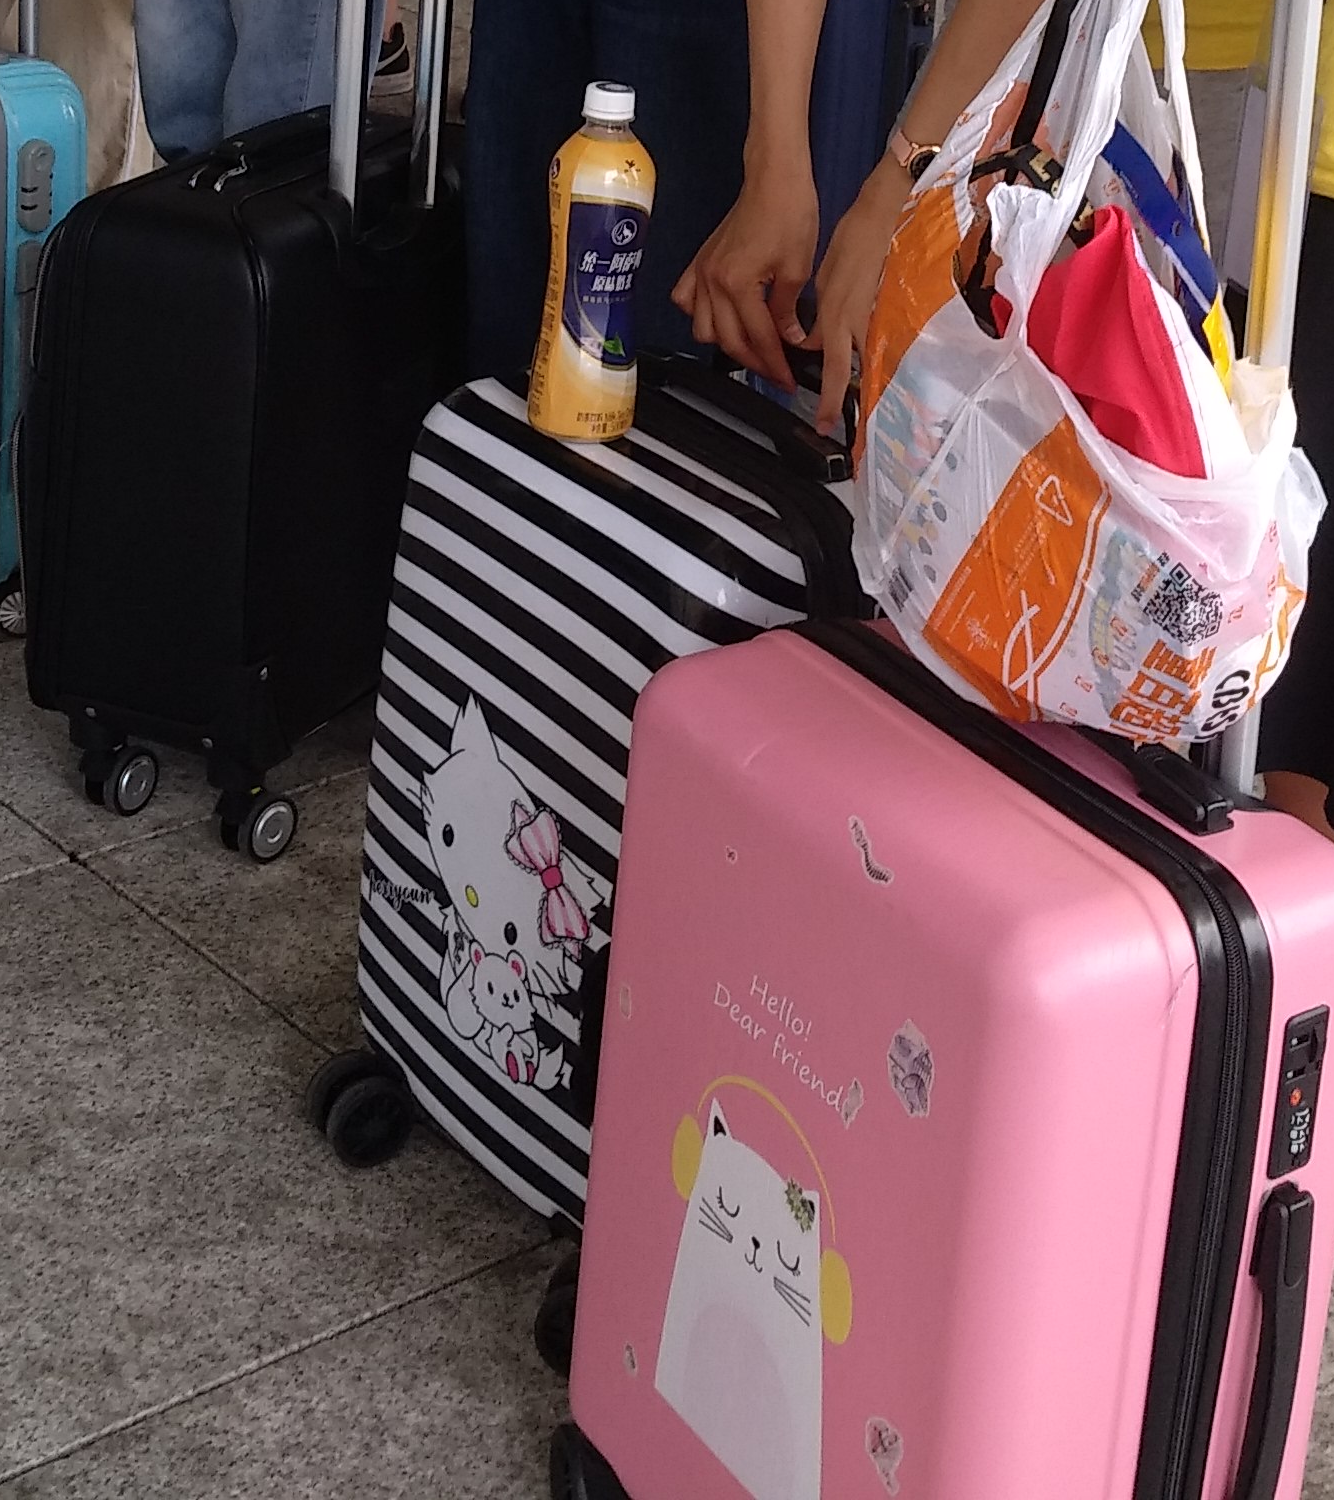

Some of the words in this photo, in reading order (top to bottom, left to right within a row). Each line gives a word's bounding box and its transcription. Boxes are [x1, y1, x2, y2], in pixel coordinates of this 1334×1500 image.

[714, 981, 767, 1041] Dear
[772, 1032, 844, 1112] friend
[750, 974, 813, 1043] Hello!
